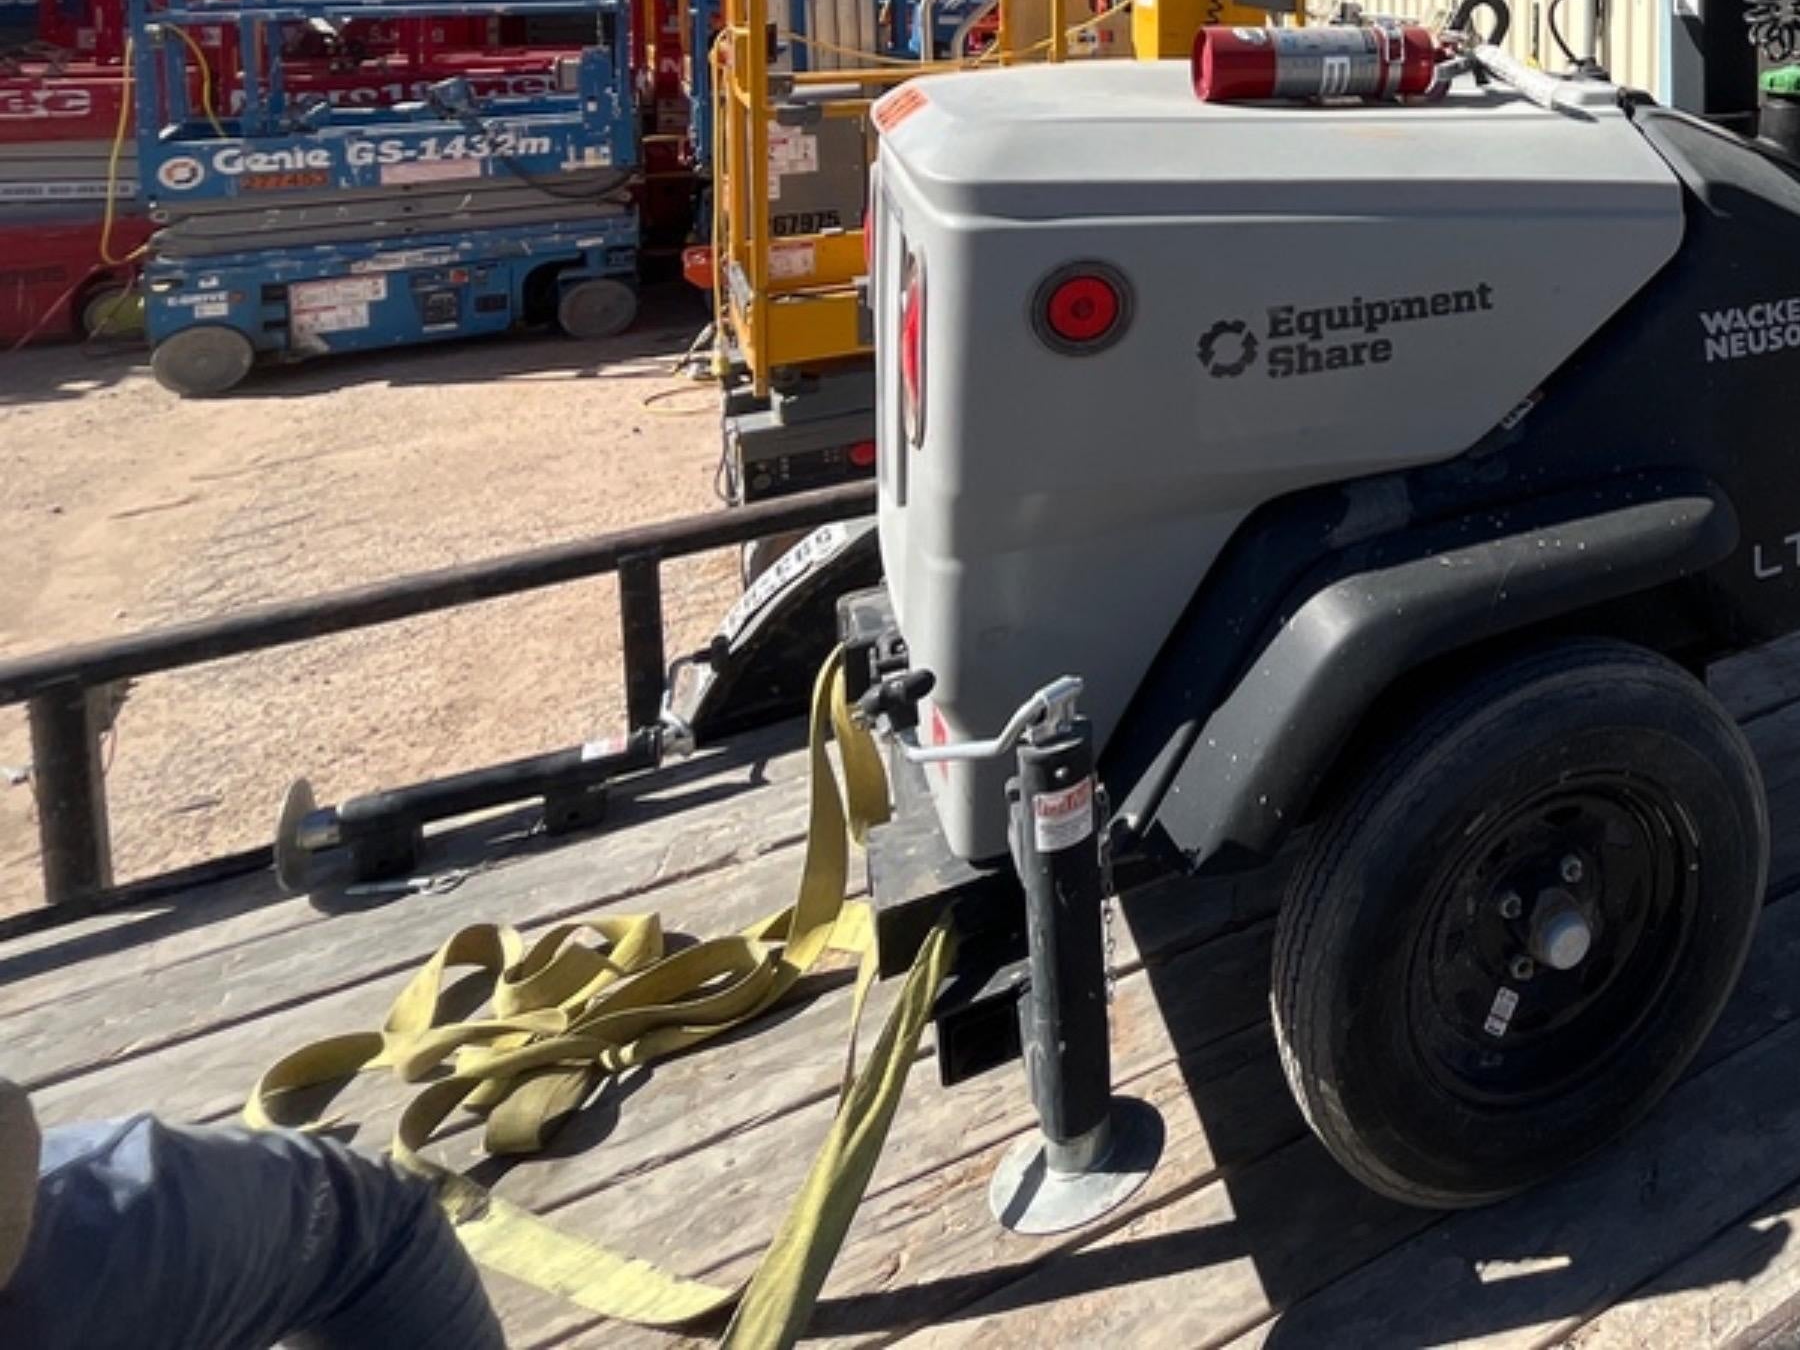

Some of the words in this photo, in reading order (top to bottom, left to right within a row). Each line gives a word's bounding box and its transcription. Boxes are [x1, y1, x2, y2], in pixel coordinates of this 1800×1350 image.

[213, 147, 331, 175] Genie
[346, 134, 550, 166] GS-1432m
[1266, 282, 1493, 341] Equipment
[1267, 337, 1393, 378] Share
